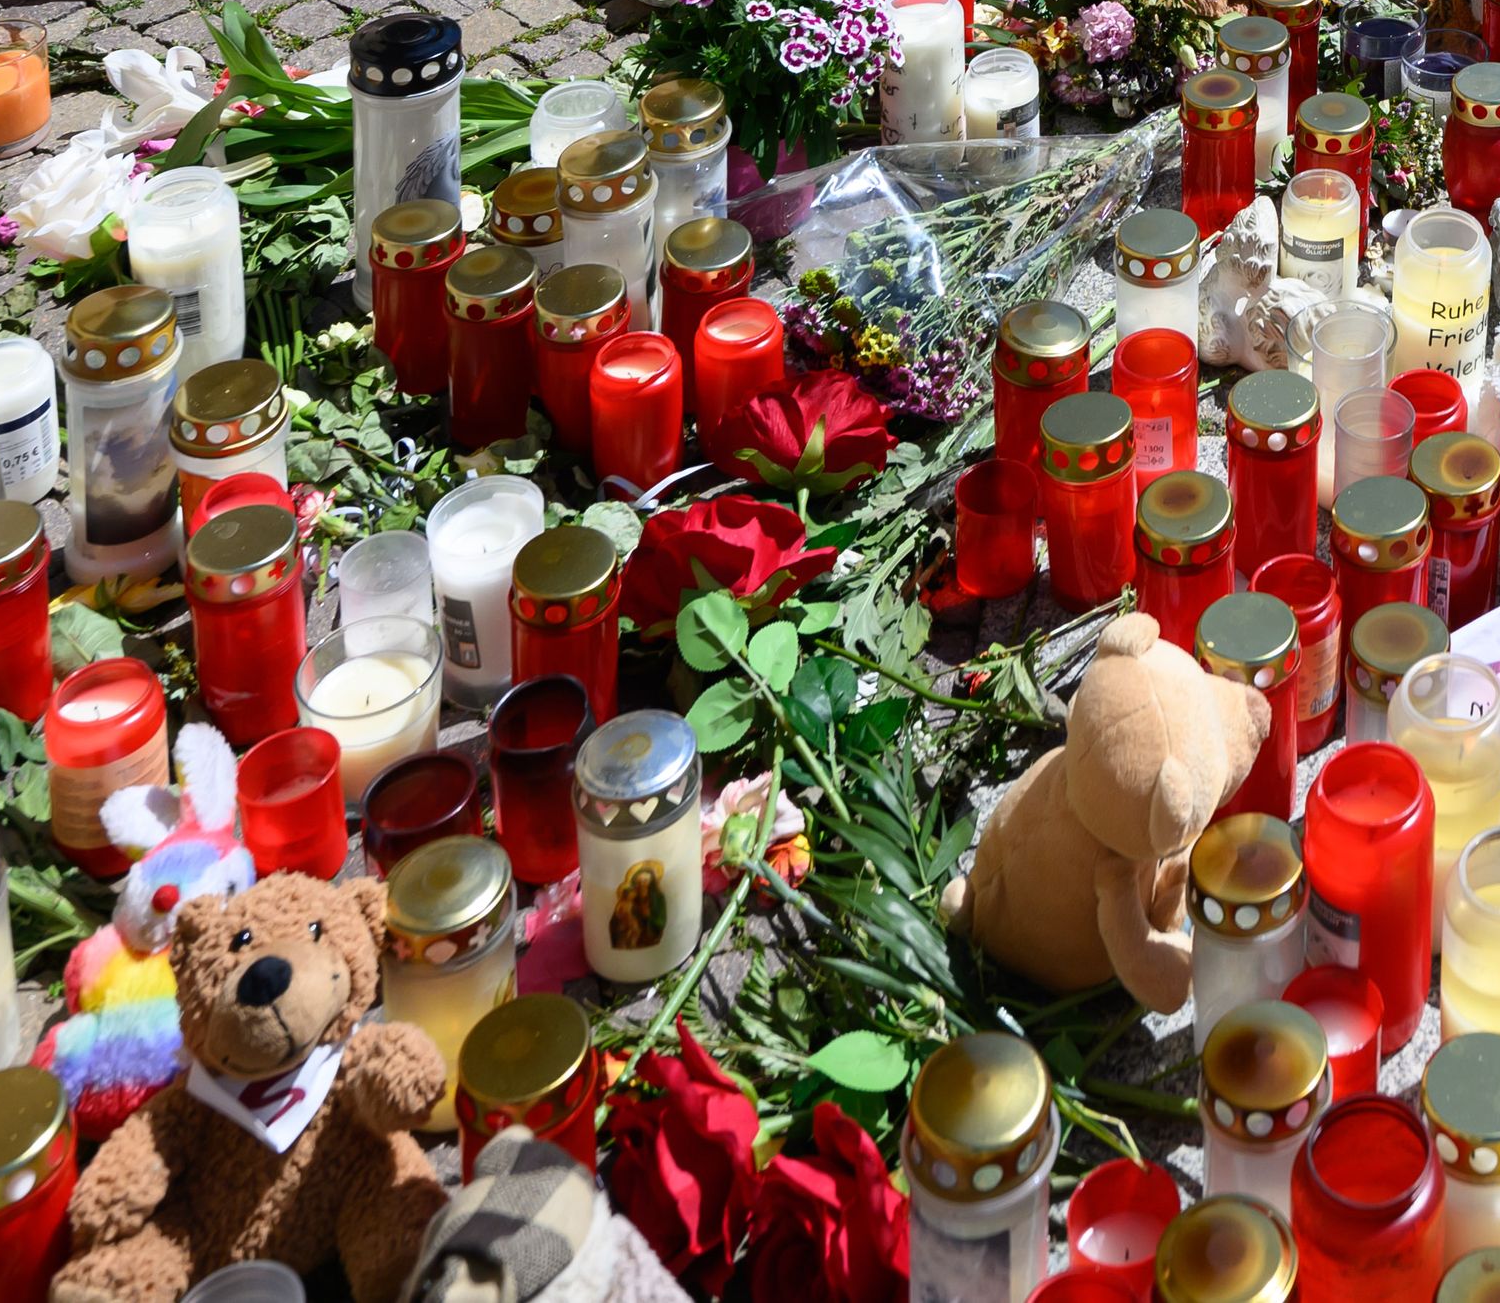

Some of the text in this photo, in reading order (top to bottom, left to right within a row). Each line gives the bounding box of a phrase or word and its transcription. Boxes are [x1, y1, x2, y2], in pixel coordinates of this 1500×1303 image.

[1431, 295, 1484, 320] Ruhe
[2, 446, 39, 470] 0,75 €
